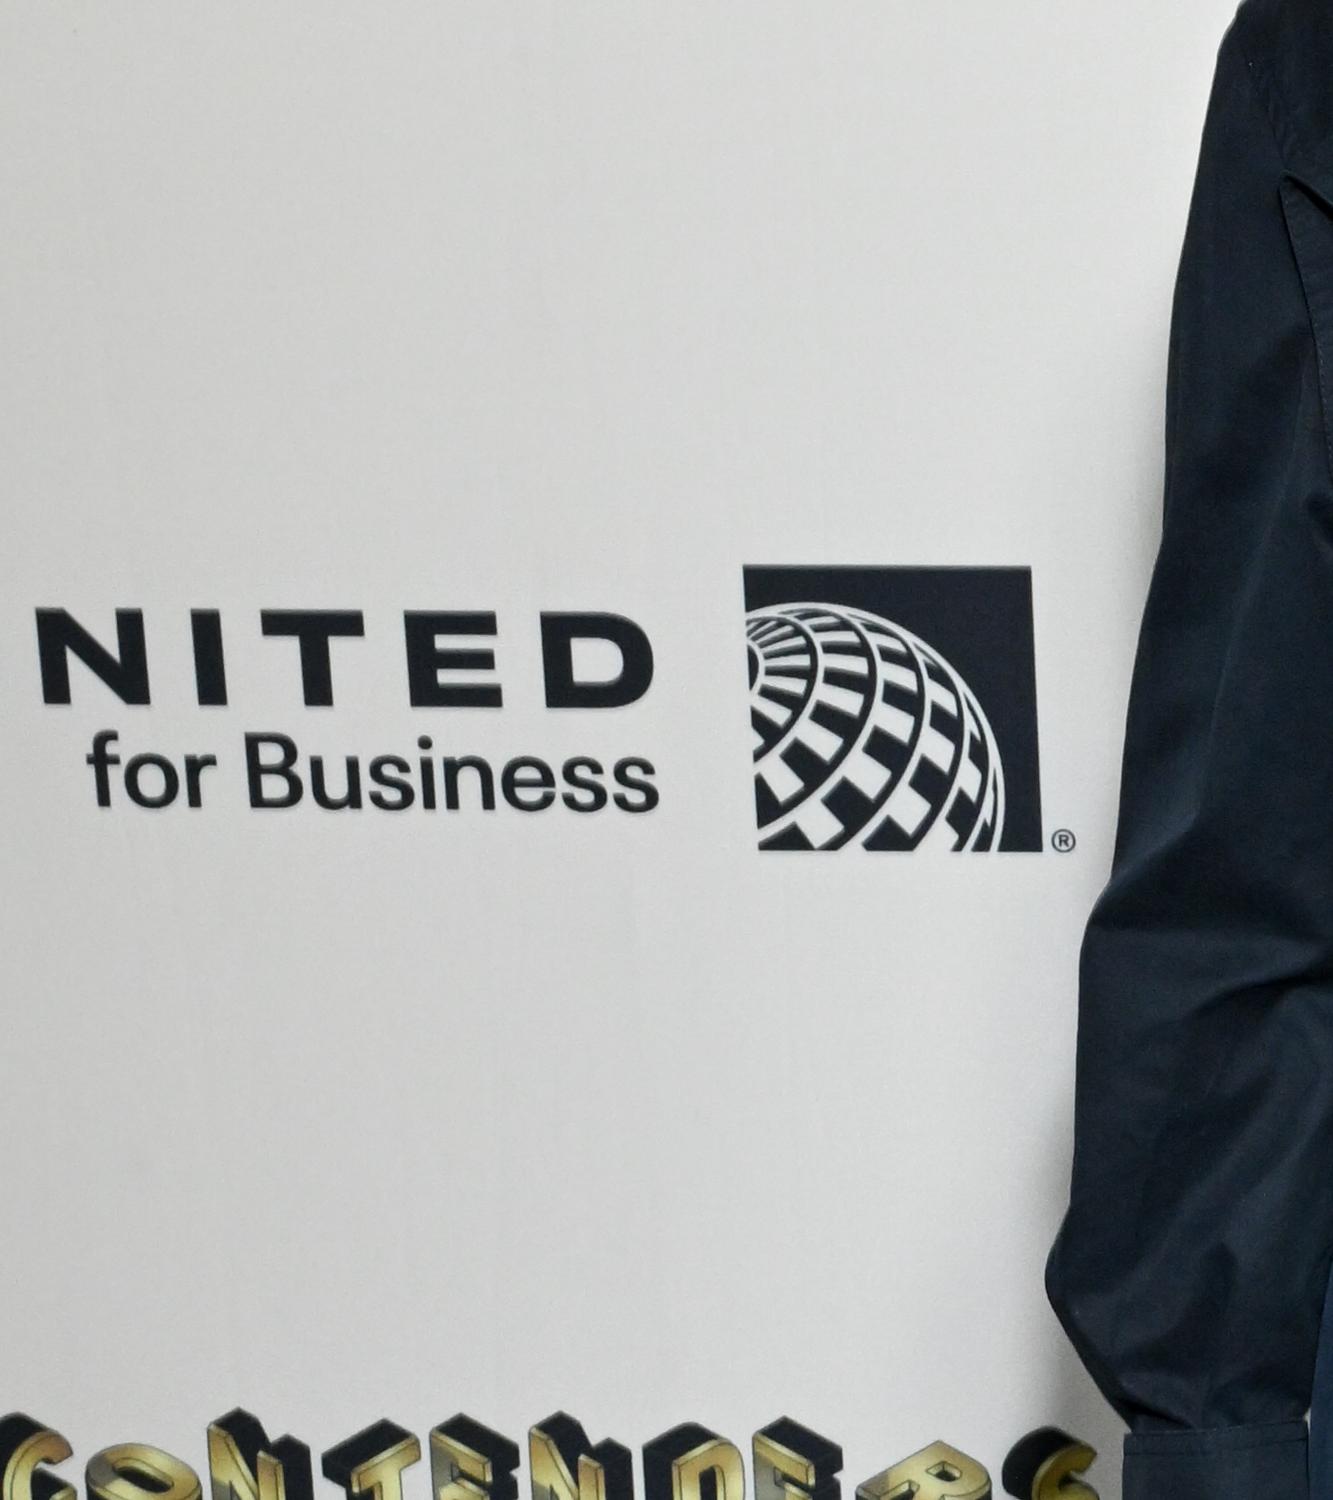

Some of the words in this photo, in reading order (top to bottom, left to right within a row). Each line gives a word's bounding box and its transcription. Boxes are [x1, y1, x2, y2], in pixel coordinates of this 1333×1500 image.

[34, 606, 655, 710] NITED
[86, 730, 219, 810] for
[243, 731, 661, 815] Business
